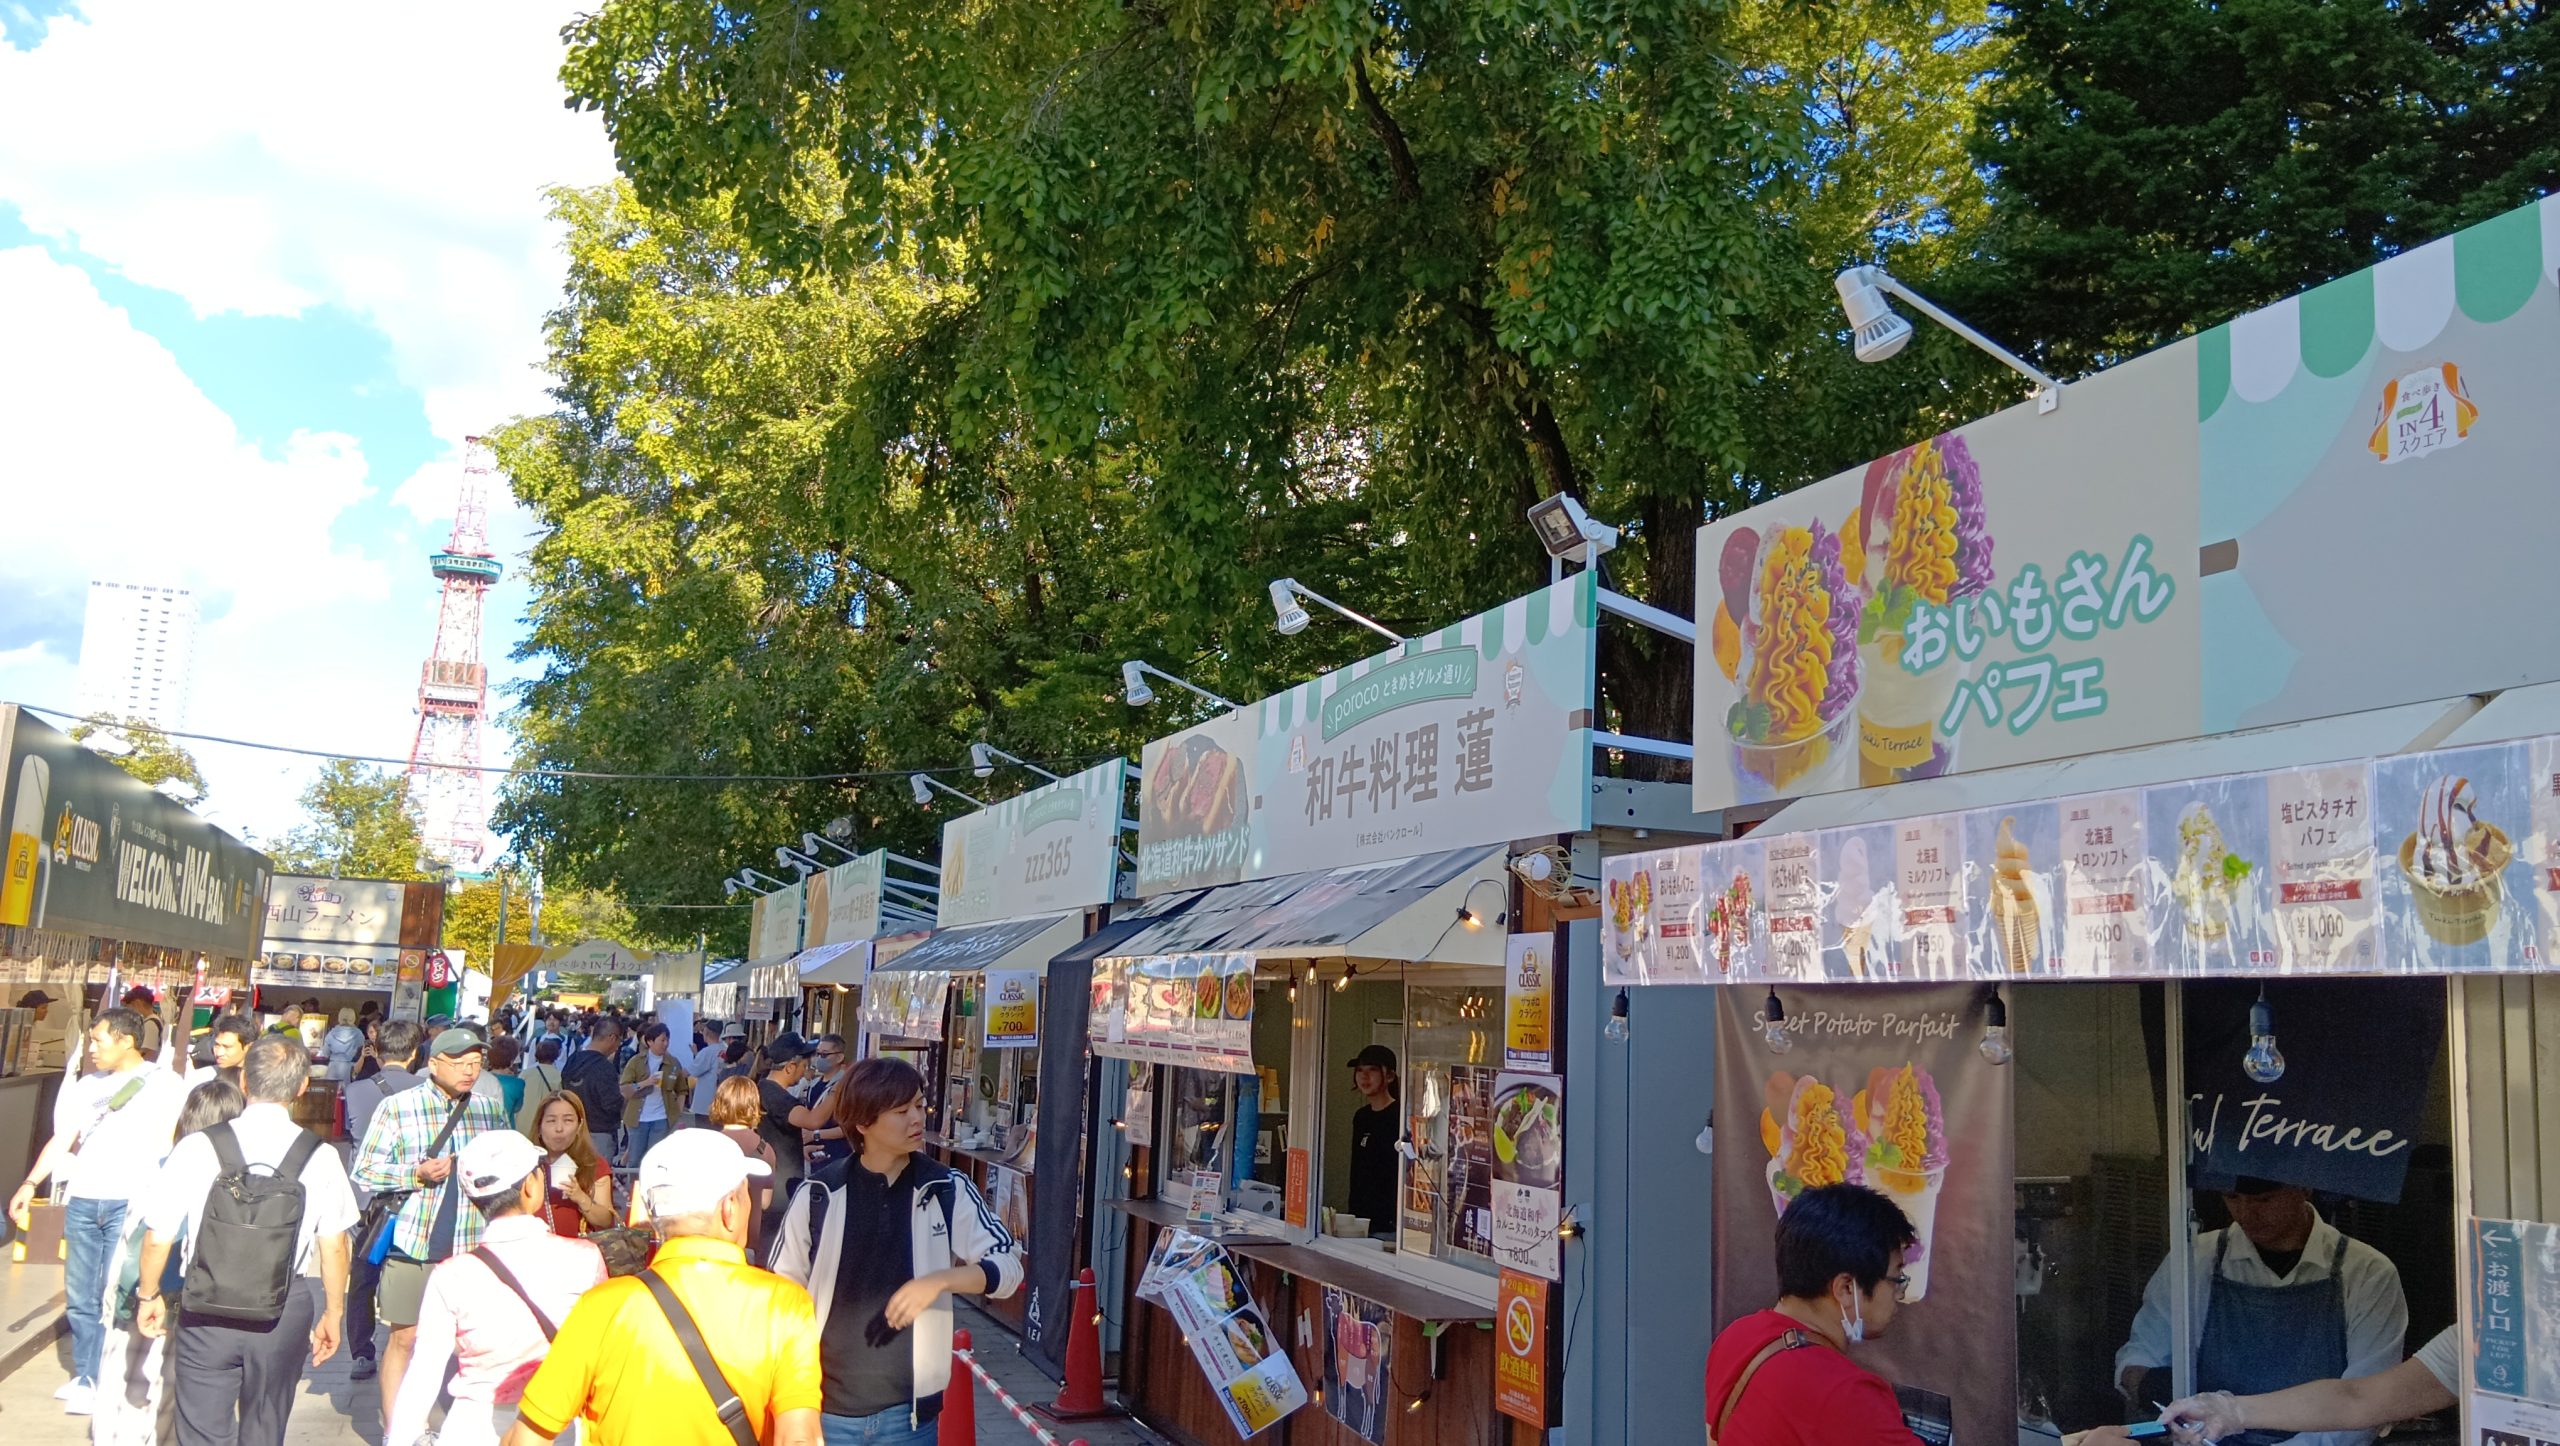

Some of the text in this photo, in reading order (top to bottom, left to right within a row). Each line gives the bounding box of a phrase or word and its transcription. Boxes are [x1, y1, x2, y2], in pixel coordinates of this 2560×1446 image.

[2401, 382, 2440, 402] 食べ歩き
[2398, 428, 2447, 456] スクエア
[1901, 540, 2170, 671] おいもさん
[1334, 683, 1380, 732] poroco
[1382, 663, 1463, 697] ときめきグルメ通り
[1943, 659, 2103, 731] パフェ
[1304, 706, 1495, 827] 和牛料理 蓮
[2281, 795, 2358, 824] 塩ピスタチオ
[71, 813, 99, 863] CLASSIC
[2085, 826, 2114, 845] 北海道
[2300, 827, 2338, 846] パフェ
[1024, 835, 1073, 885] zzz365
[1140, 825, 1250, 885] 北海道和牛カツサンド
[1916, 847, 1938, 864] 北海道
[2072, 848, 2129, 875] メロンソフト
[117, 839, 183, 914] WELCOME
[1907, 866, 1951, 884] ミルクソフト
[266, 904, 376, 926] 西山ラーメン
[2297, 914, 2344, 939] ¥1,000
[2085, 923, 2122, 942] ¥600
[1518, 973, 1542, 987] CLASSIC
[999, 992, 1025, 1001] CLASSIC
[1520, 997, 1540, 1007] サッポロ
[1518, 1009, 1542, 1019] クラシック
[1752, 1010, 1960, 1044] Seet Potato Parfait
[2238, 1092, 2408, 1157] Terrace
[1505, 1203, 1542, 1223] 北海道和牛
[1496, 1217, 1554, 1240] カルニタスのタコス
[2486, 1260, 2511, 1332] お渡し口
[1511, 1309, 1531, 1344] 20
[1499, 1351, 1540, 1386] 飲酒禁止
[1264, 1376, 1284, 1402] CLASSIC
